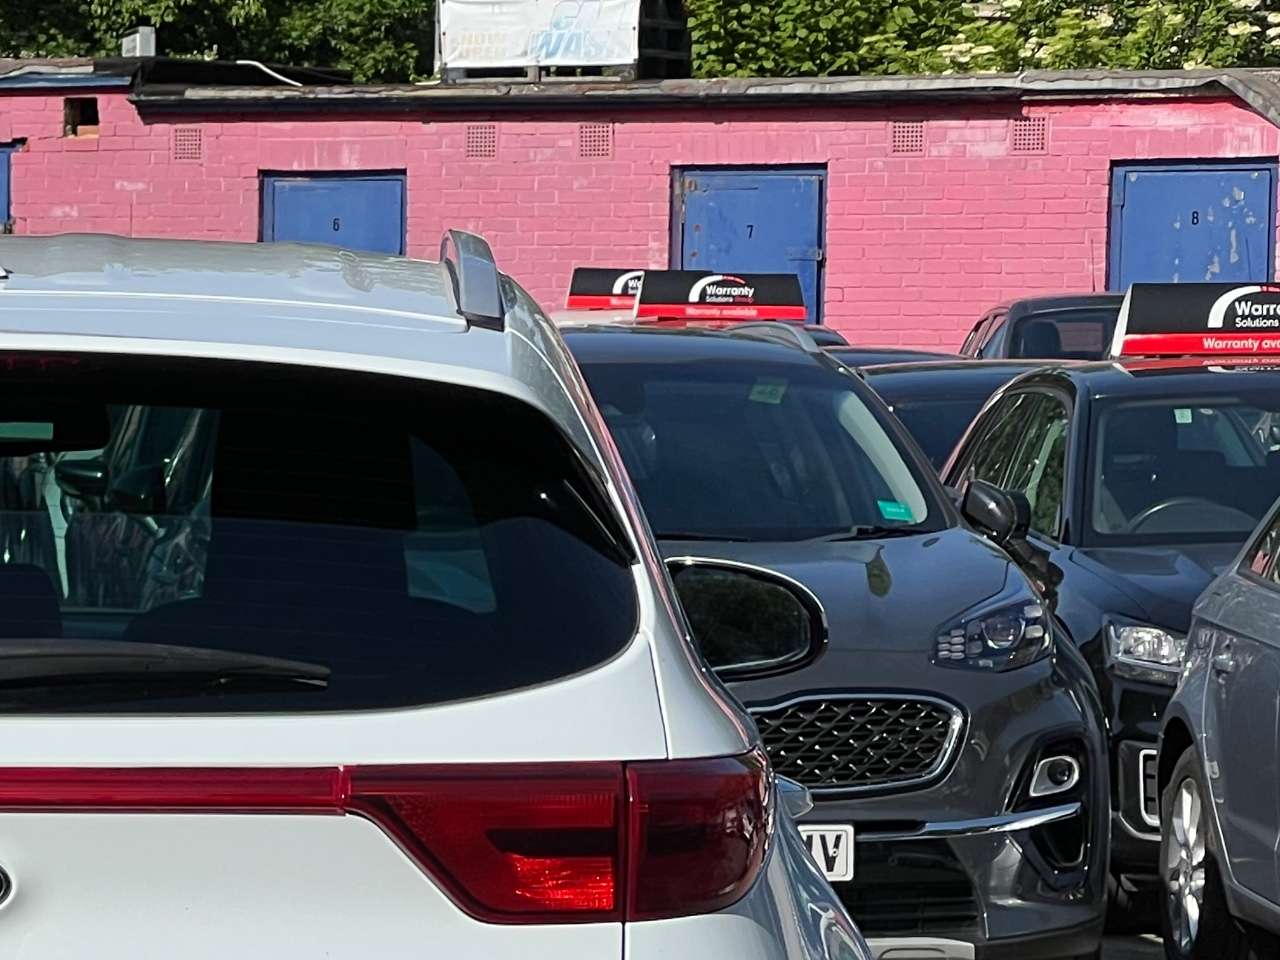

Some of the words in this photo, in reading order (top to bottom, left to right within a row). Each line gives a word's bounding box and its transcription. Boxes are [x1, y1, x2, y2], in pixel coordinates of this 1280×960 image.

[332, 218, 340, 231] 6
[1191, 210, 1199, 225] 8
[746, 224, 754, 239] 7
[705, 284, 755, 298] Warranty
[1235, 317, 1280, 328] Solutions
[1202, 337, 1260, 352] Warranty
[805, 834, 842, 872] V
